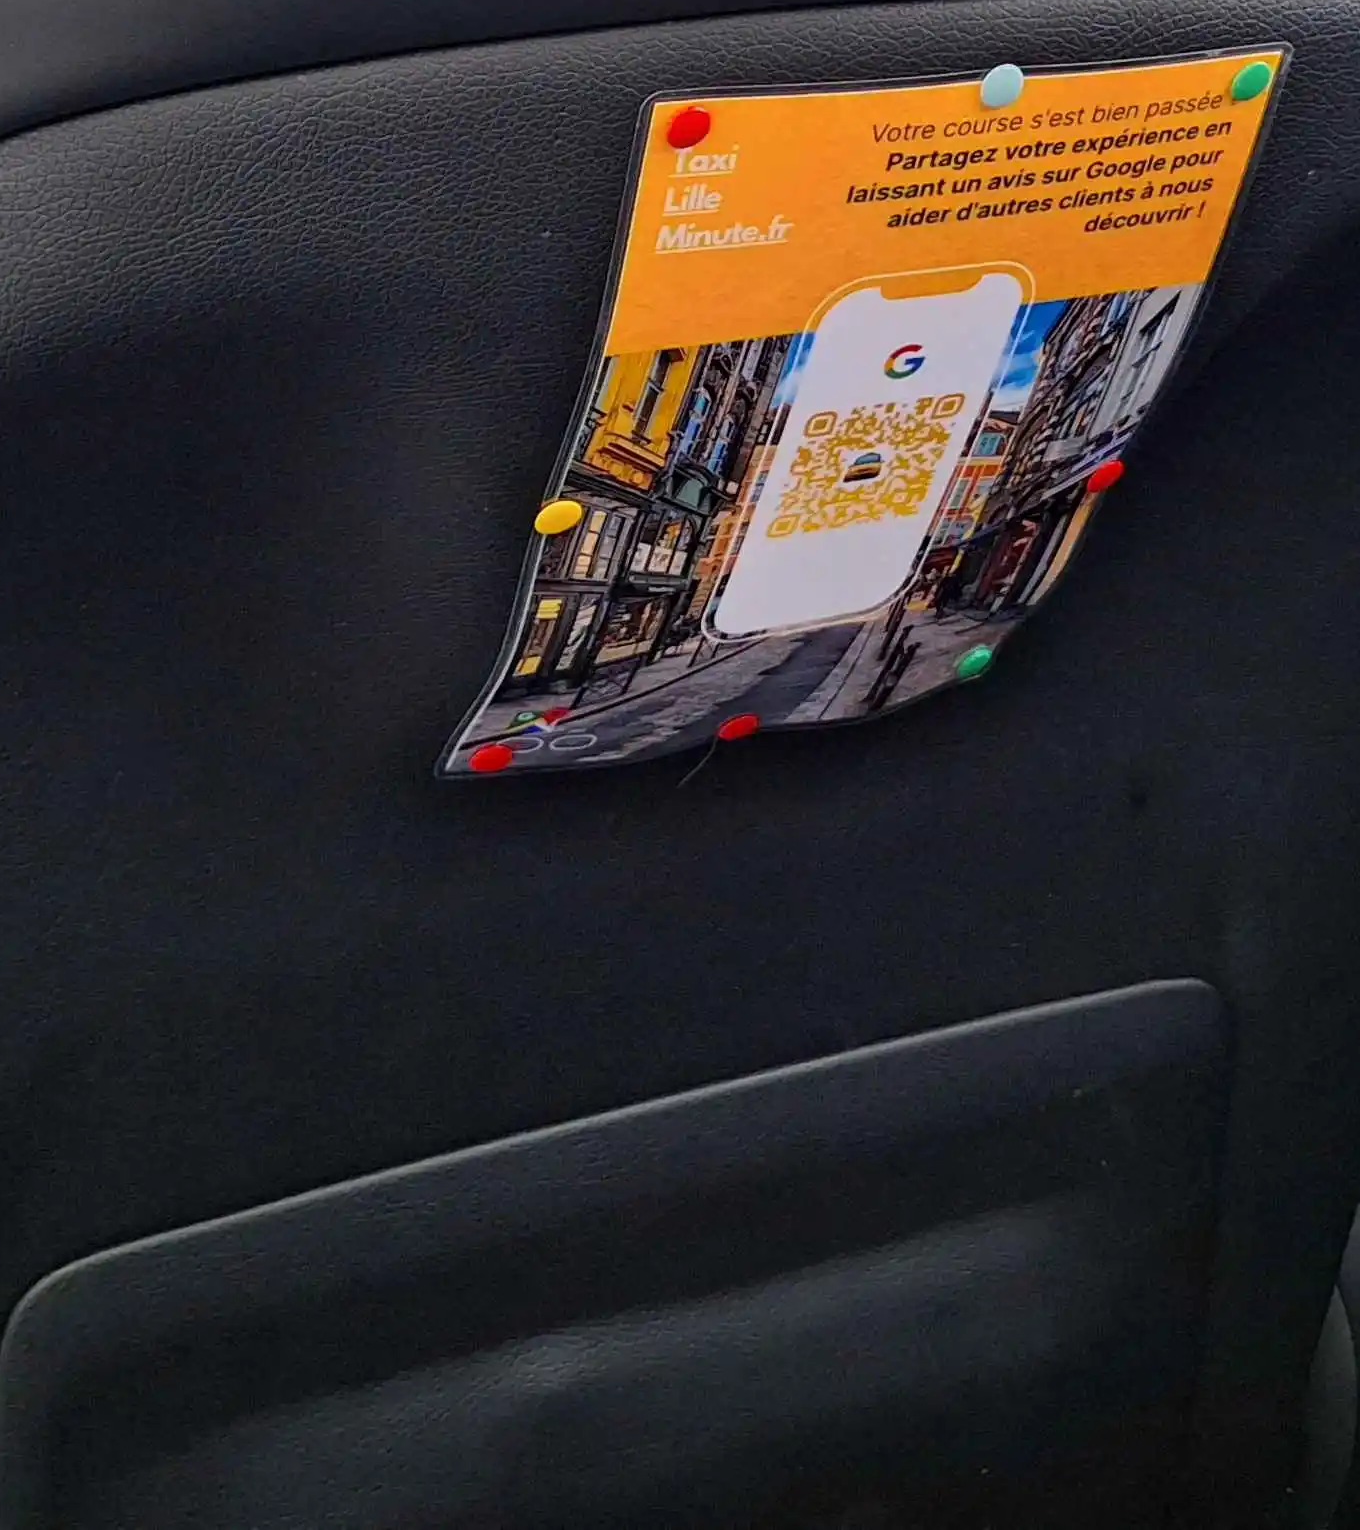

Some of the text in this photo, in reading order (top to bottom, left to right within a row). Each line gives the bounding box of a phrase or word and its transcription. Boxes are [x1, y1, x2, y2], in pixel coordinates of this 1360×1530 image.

[872, 90, 1224, 143] Votre course s'est bien passée
[672, 145, 739, 175] Taxi
[886, 121, 1232, 171] Partagez votre expérience en
[846, 149, 1224, 204] laissant un avis sur Google pour
[663, 184, 722, 214] Lille
[886, 176, 1213, 228] aider d'autres clients à nous
[1084, 201, 1206, 233] découvrir !
[656, 214, 794, 252] Minute.fr
